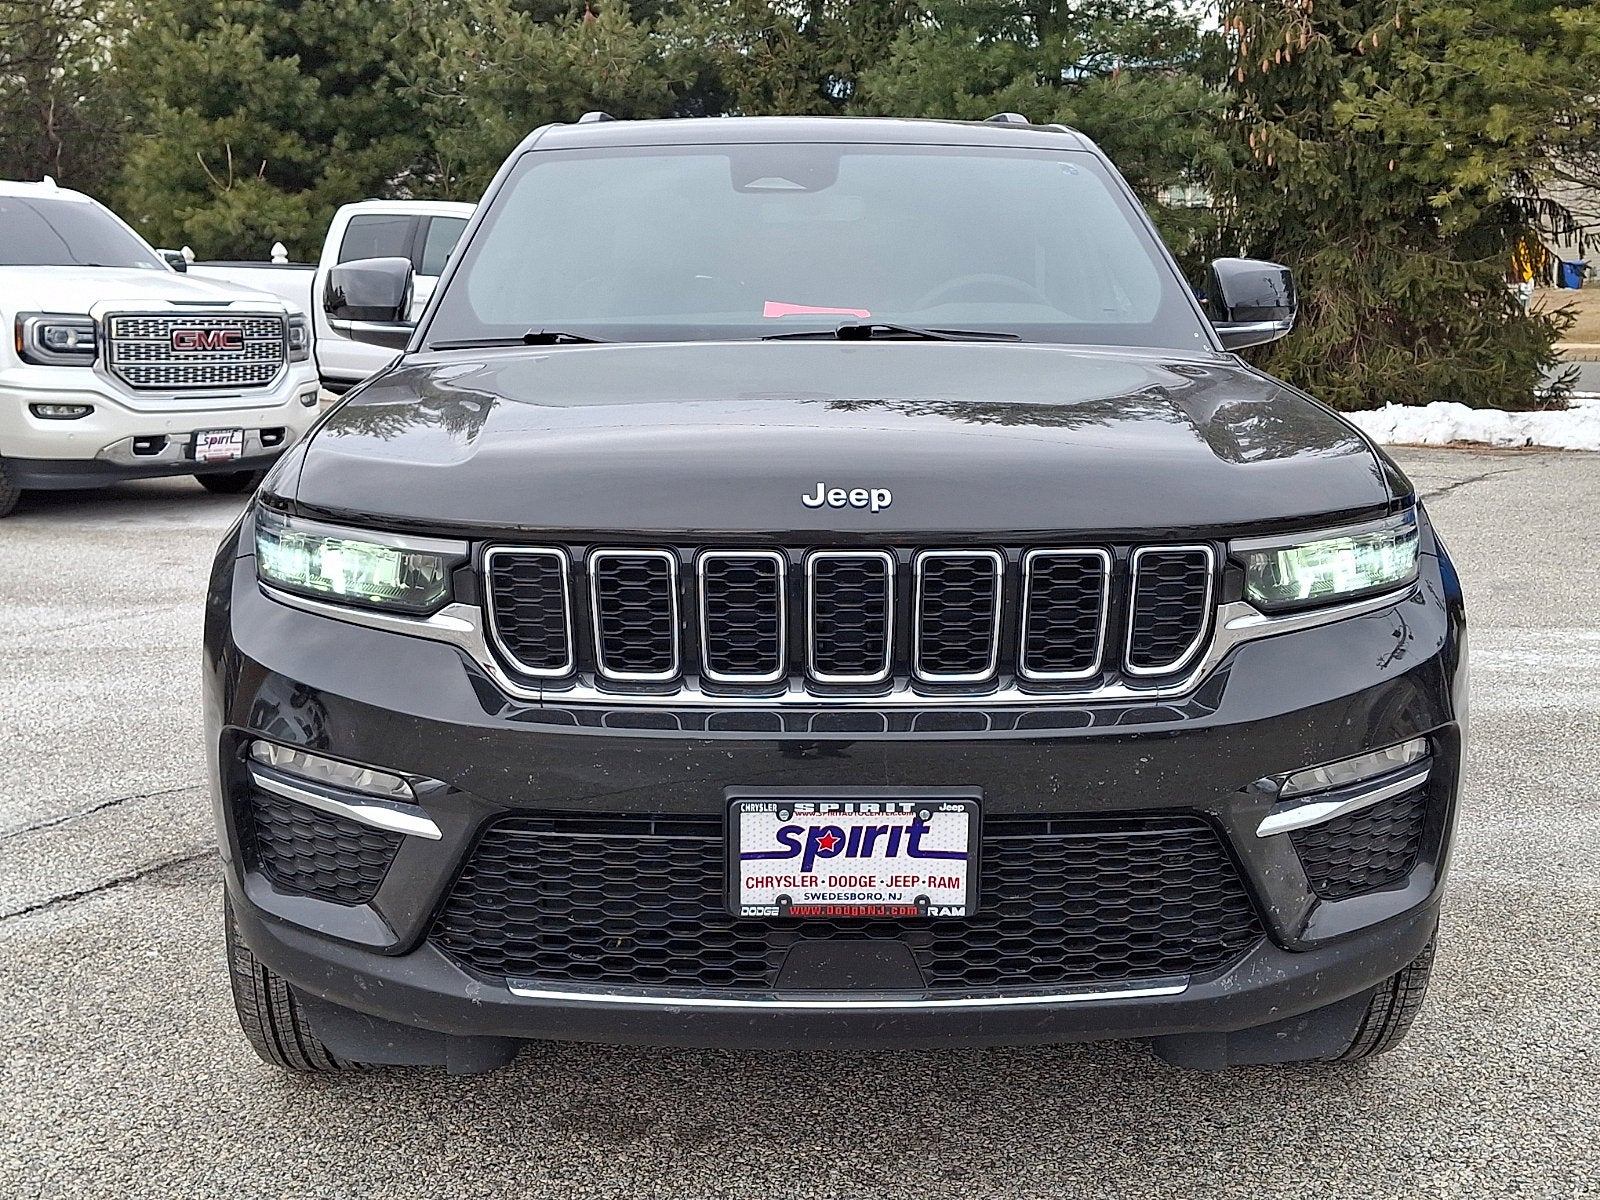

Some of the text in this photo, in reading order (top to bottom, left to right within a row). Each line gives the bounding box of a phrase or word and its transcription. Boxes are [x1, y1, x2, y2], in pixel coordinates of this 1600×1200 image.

[173, 331, 243, 350] GMC
[203, 430, 236, 449] spirit
[801, 482, 893, 514] Jeep
[740, 803, 778, 812] CHRYSLER
[794, 803, 915, 812] SPIRIT
[939, 803, 965, 812] Jeep
[776, 817, 931, 873] spirit
[745, 875, 960, 890] CHRYSLER DODGE JEEP RAM
[803, 892, 903, 902] SWEDESBORO, NJ
[740, 906, 780, 916] DODGE
[927, 906, 966, 917] RAM
